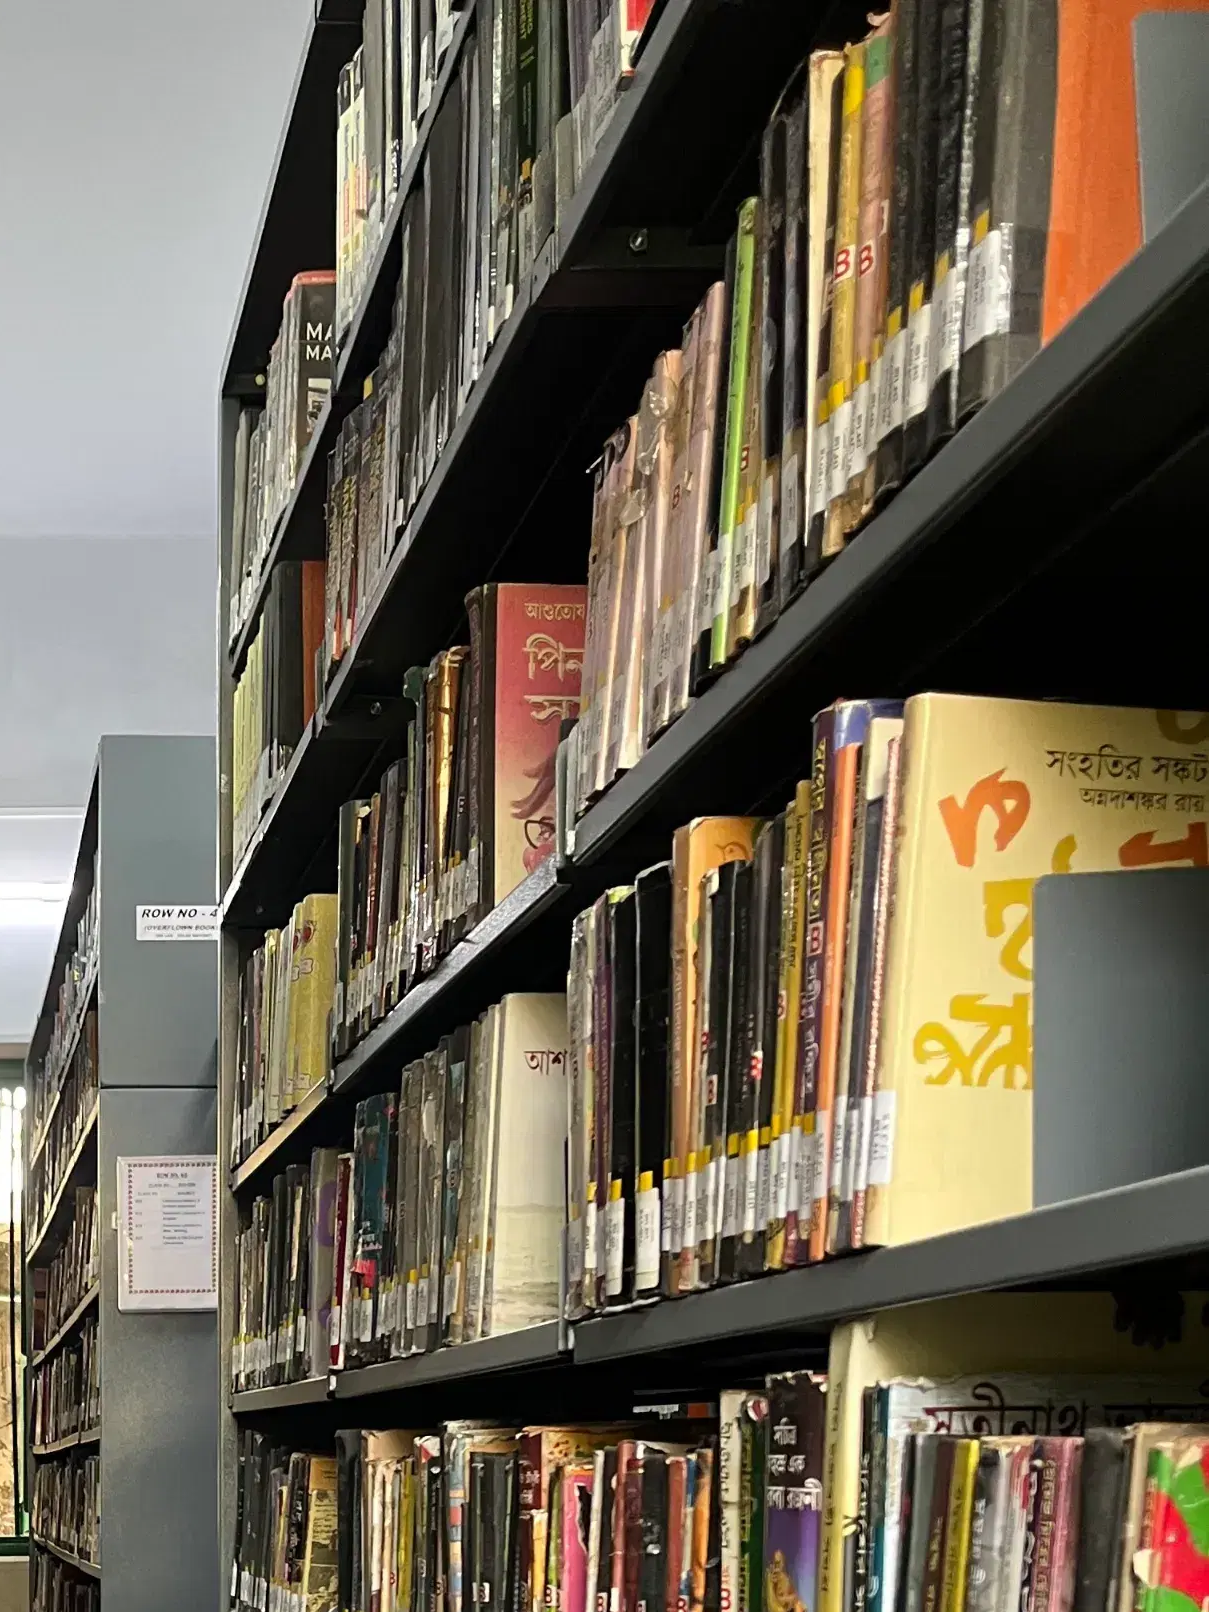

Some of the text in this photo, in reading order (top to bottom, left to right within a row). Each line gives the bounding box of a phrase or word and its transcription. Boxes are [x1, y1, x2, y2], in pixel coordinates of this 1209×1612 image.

[835, 249, 850, 280] B
[859, 244, 873, 275] B
[306, 344, 336, 362] MA
[1046, 743, 1209, 784] সংহতির সঙ্কট
[1079, 788, 1205, 813] অন্নদাশঙ্কর রায়
[142, 908, 174, 918] ROW
[177, 908, 197, 918] NO
[811, 927, 821, 953] B
[721, 1588, 732, 1611] B
